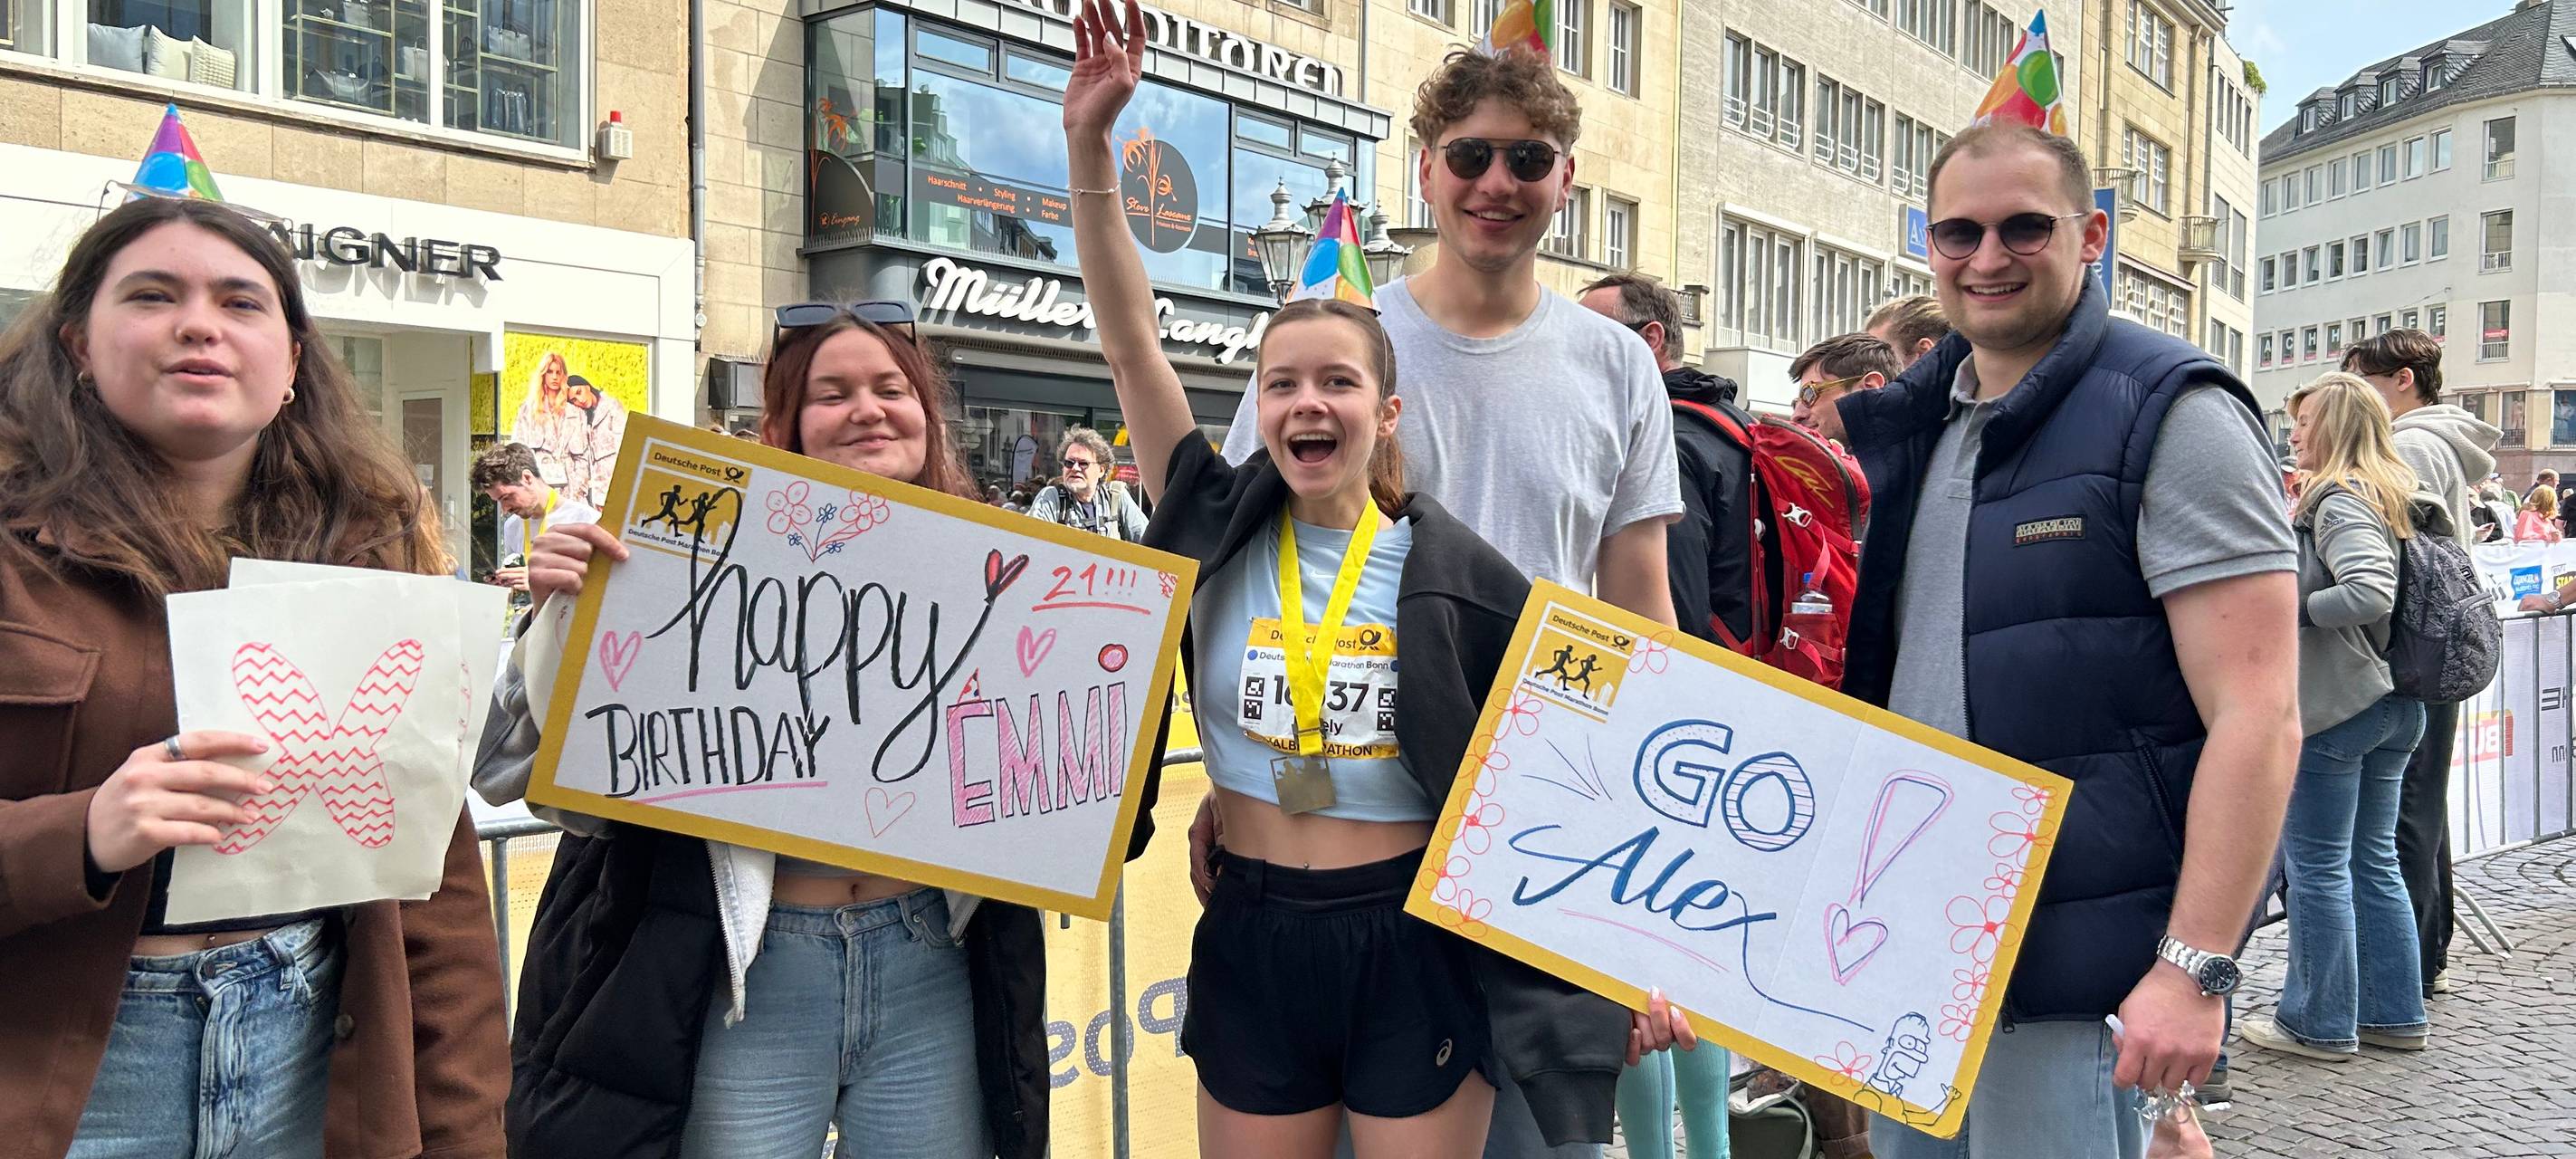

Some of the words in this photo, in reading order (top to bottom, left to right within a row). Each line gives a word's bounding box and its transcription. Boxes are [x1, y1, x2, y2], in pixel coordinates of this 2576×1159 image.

[927, 176, 968, 191] Haarschnitt
[994, 187, 1016, 202] Styling
[1042, 196, 1067, 212] Makeup
[831, 212, 860, 228] Eingang
[1041, 209, 1059, 221] Farbe
[654, 452, 699, 471] Deutsche
[700, 464, 722, 477] Post
[627, 528, 661, 542] Deutsche
[661, 536, 678, 546] Post
[1043, 563, 1139, 603] 21!!!
[645, 486, 994, 783] happy
[1552, 615, 1590, 634] Deutsche
[1591, 629, 1610, 643] Post
[1331, 659, 1365, 670] arathon
[1366, 660, 1389, 671] Bonn
[1522, 677, 1550, 693] Deutsche
[1550, 687, 1565, 699] Post
[1564, 694, 1593, 710] Marathon
[1593, 704, 1609, 716] Bonn
[586, 703, 831, 799] BIRTHDAY
[1633, 719, 1816, 852] GO
